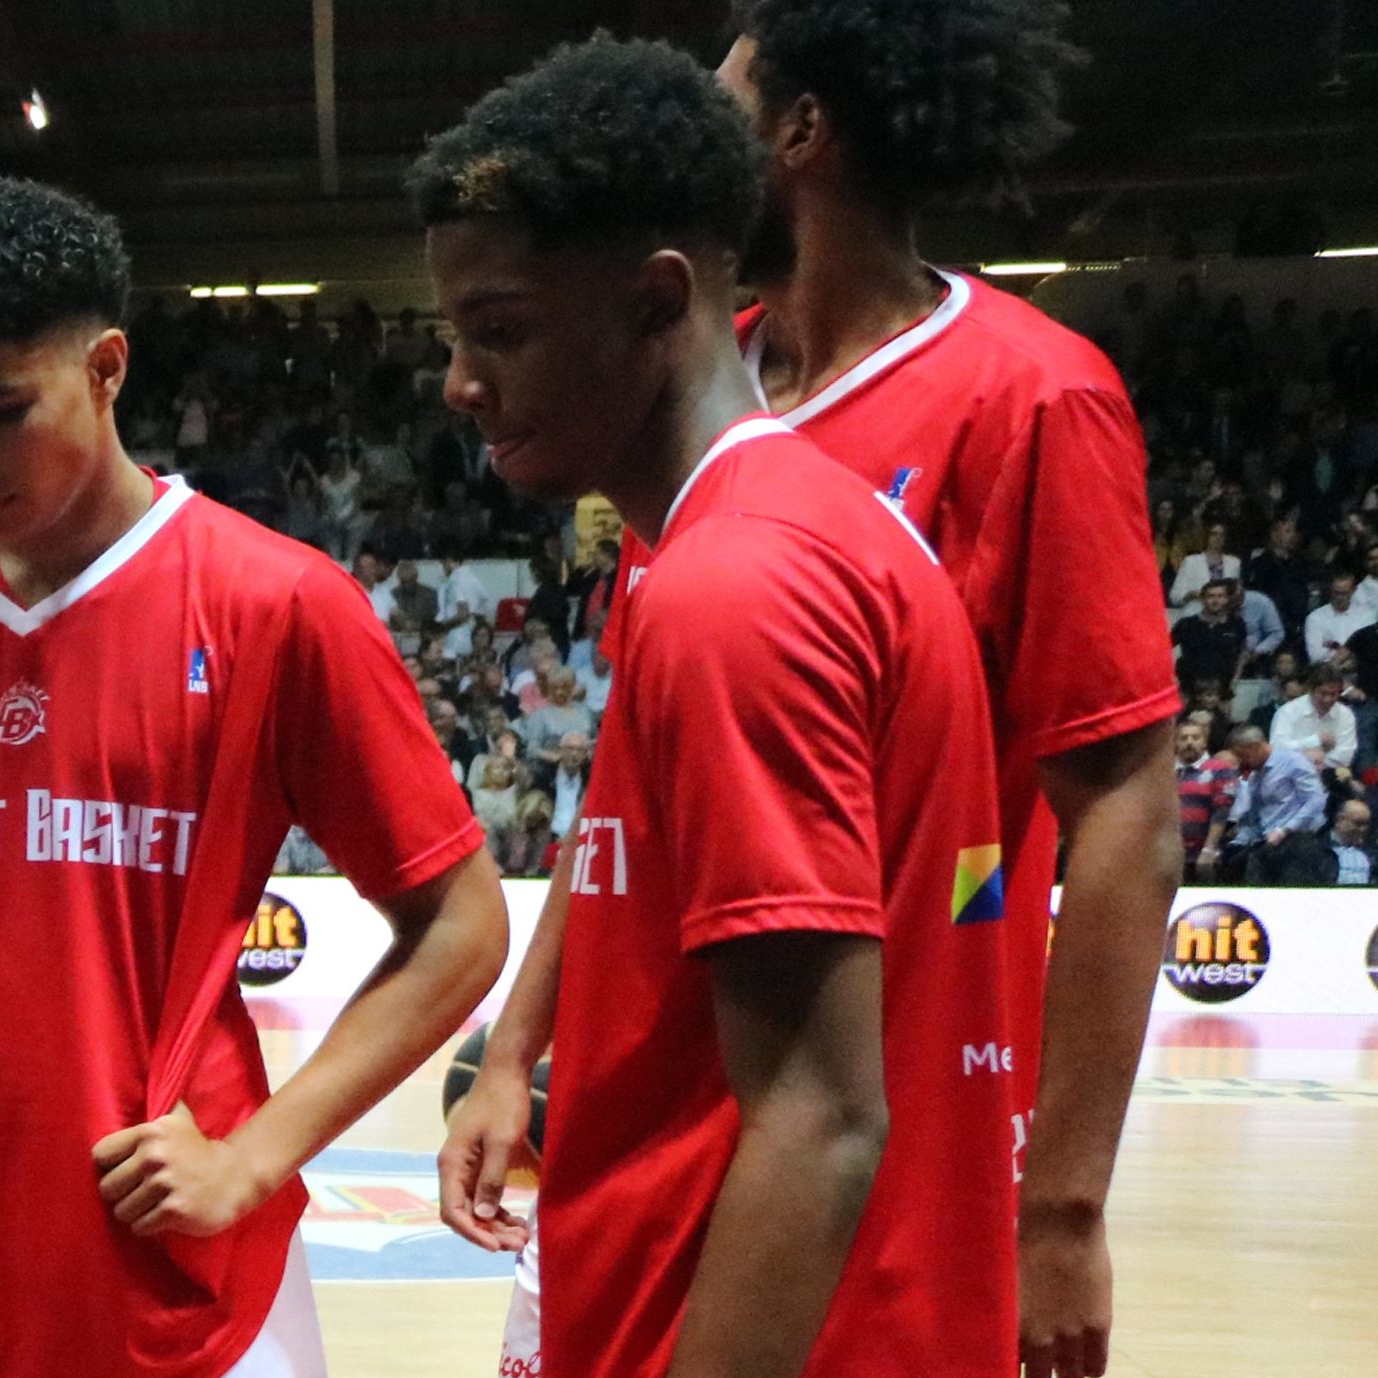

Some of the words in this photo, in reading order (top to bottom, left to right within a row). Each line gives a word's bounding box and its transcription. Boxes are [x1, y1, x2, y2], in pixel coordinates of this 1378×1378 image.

[26, 787, 197, 876] BASKET
[1175, 916, 1260, 962] hit
[1163, 963, 1267, 985] west
